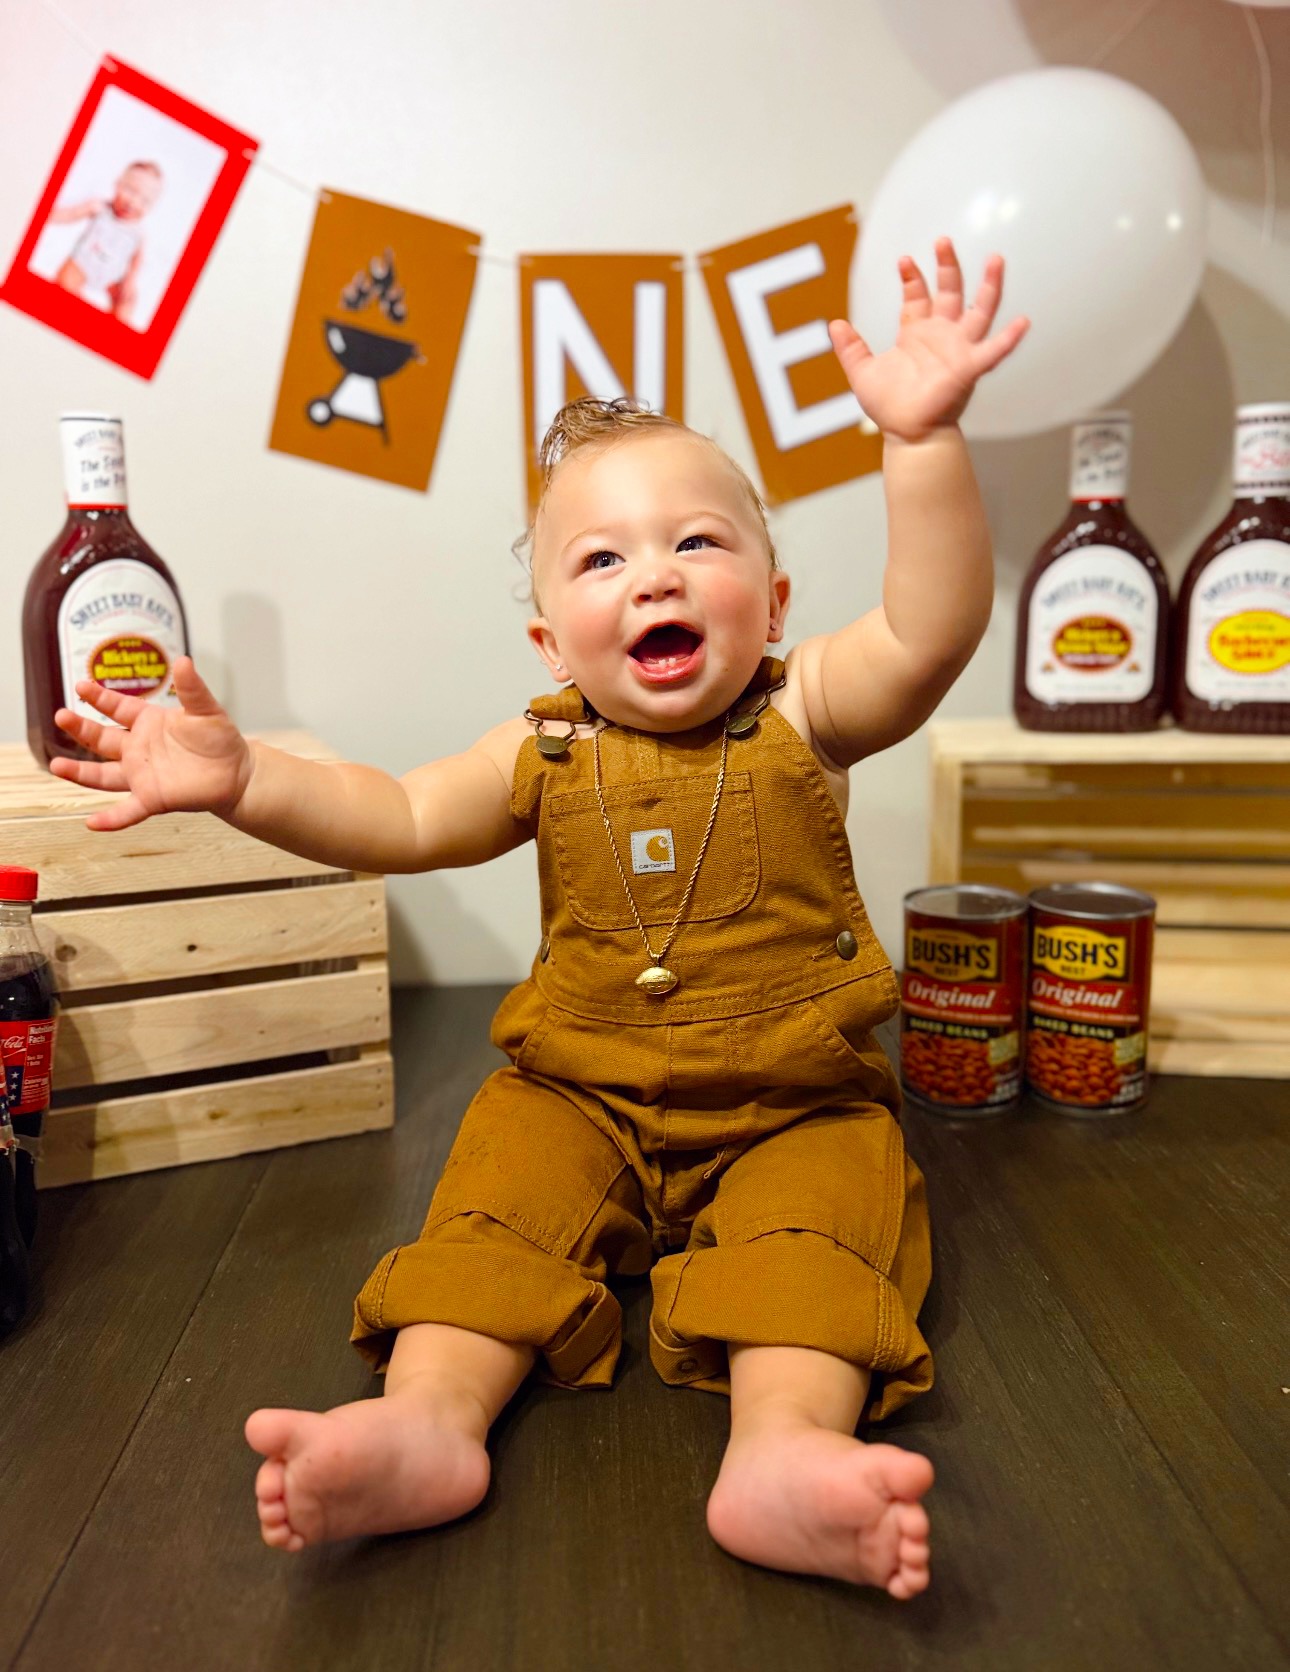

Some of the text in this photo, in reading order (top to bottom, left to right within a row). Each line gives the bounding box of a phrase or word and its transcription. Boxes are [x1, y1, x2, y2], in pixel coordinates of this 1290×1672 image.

[81, 459, 100, 473] The
[70, 596, 109, 630] SWEET
[112, 592, 144, 607] BABY
[911, 936, 992, 970] BUSH'S
[1036, 933, 1120, 969] BUSH'S
[907, 979, 996, 1009] Original
[1031, 977, 1124, 1009] Original
